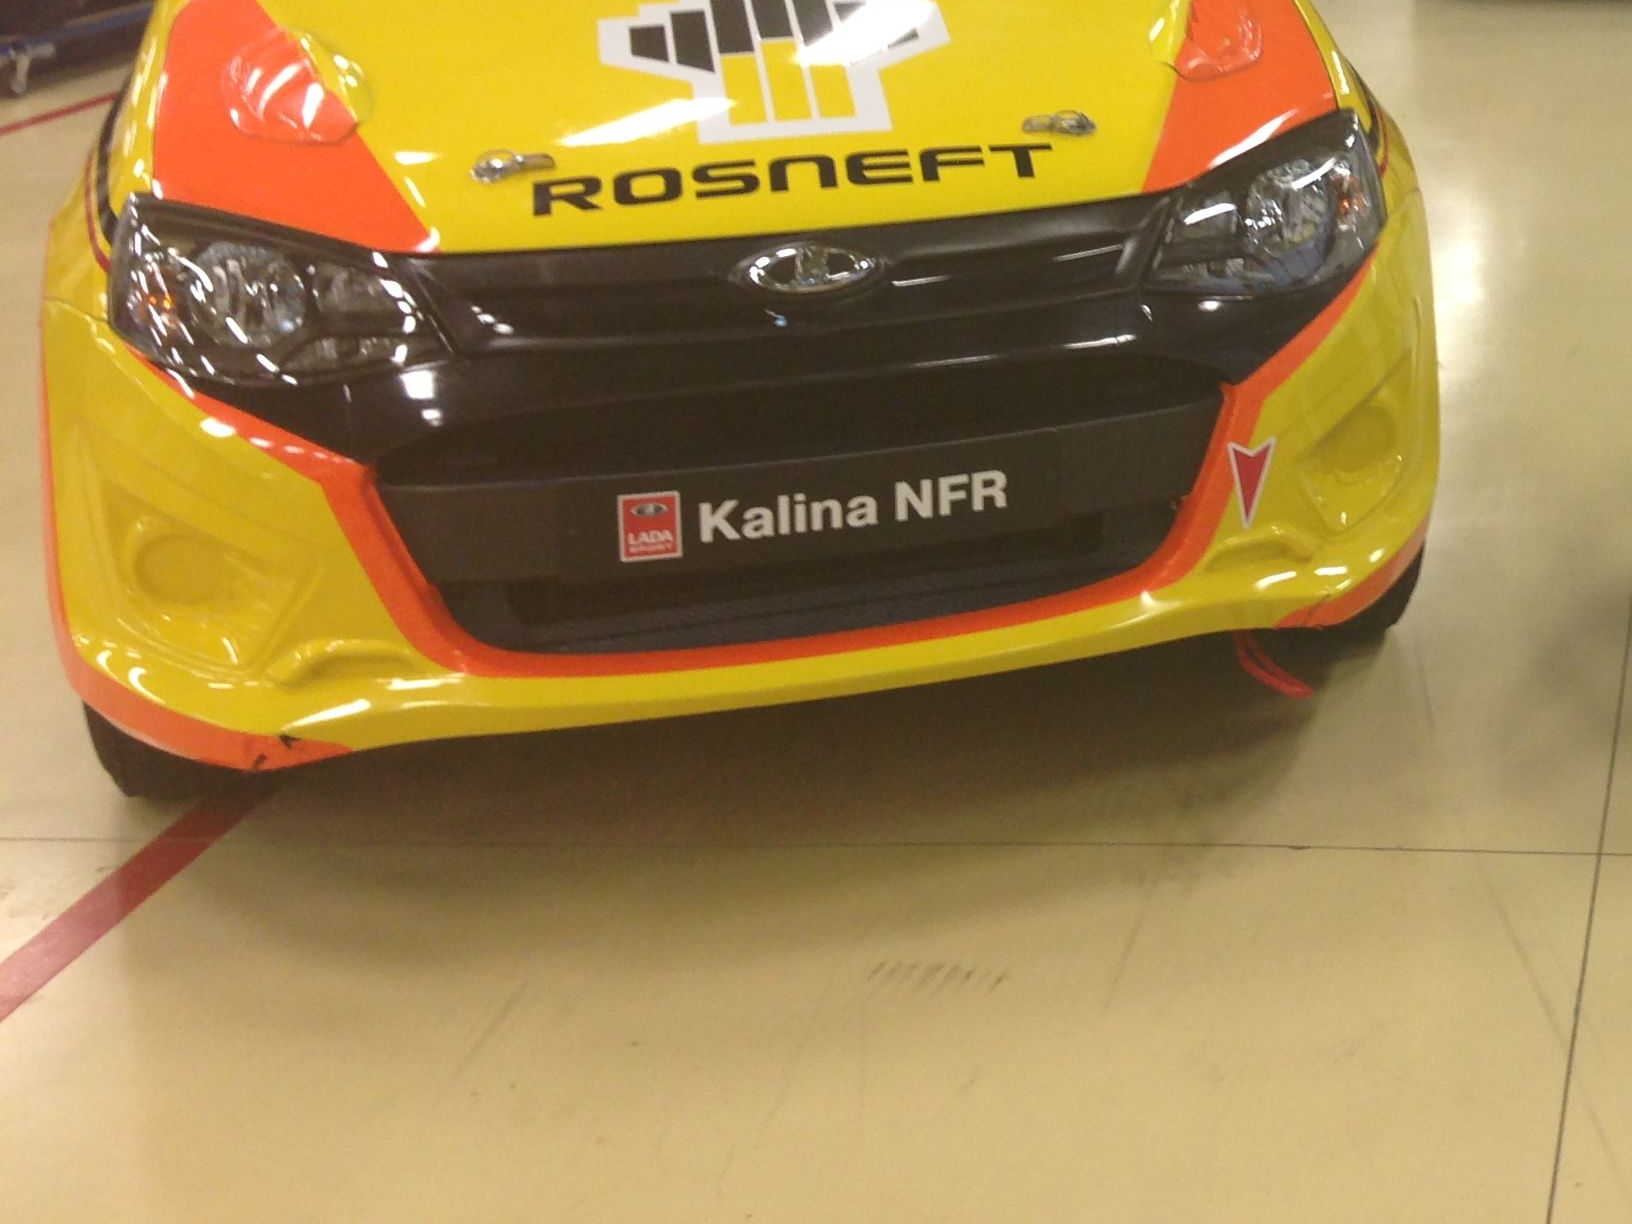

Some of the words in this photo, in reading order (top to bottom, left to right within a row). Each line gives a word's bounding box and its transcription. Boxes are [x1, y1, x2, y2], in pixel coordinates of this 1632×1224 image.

[533, 143, 1052, 216] ROSNEFT
[628, 529, 673, 545] LADA
[699, 494, 879, 543] Kalina
[895, 470, 1009, 522] NFR
